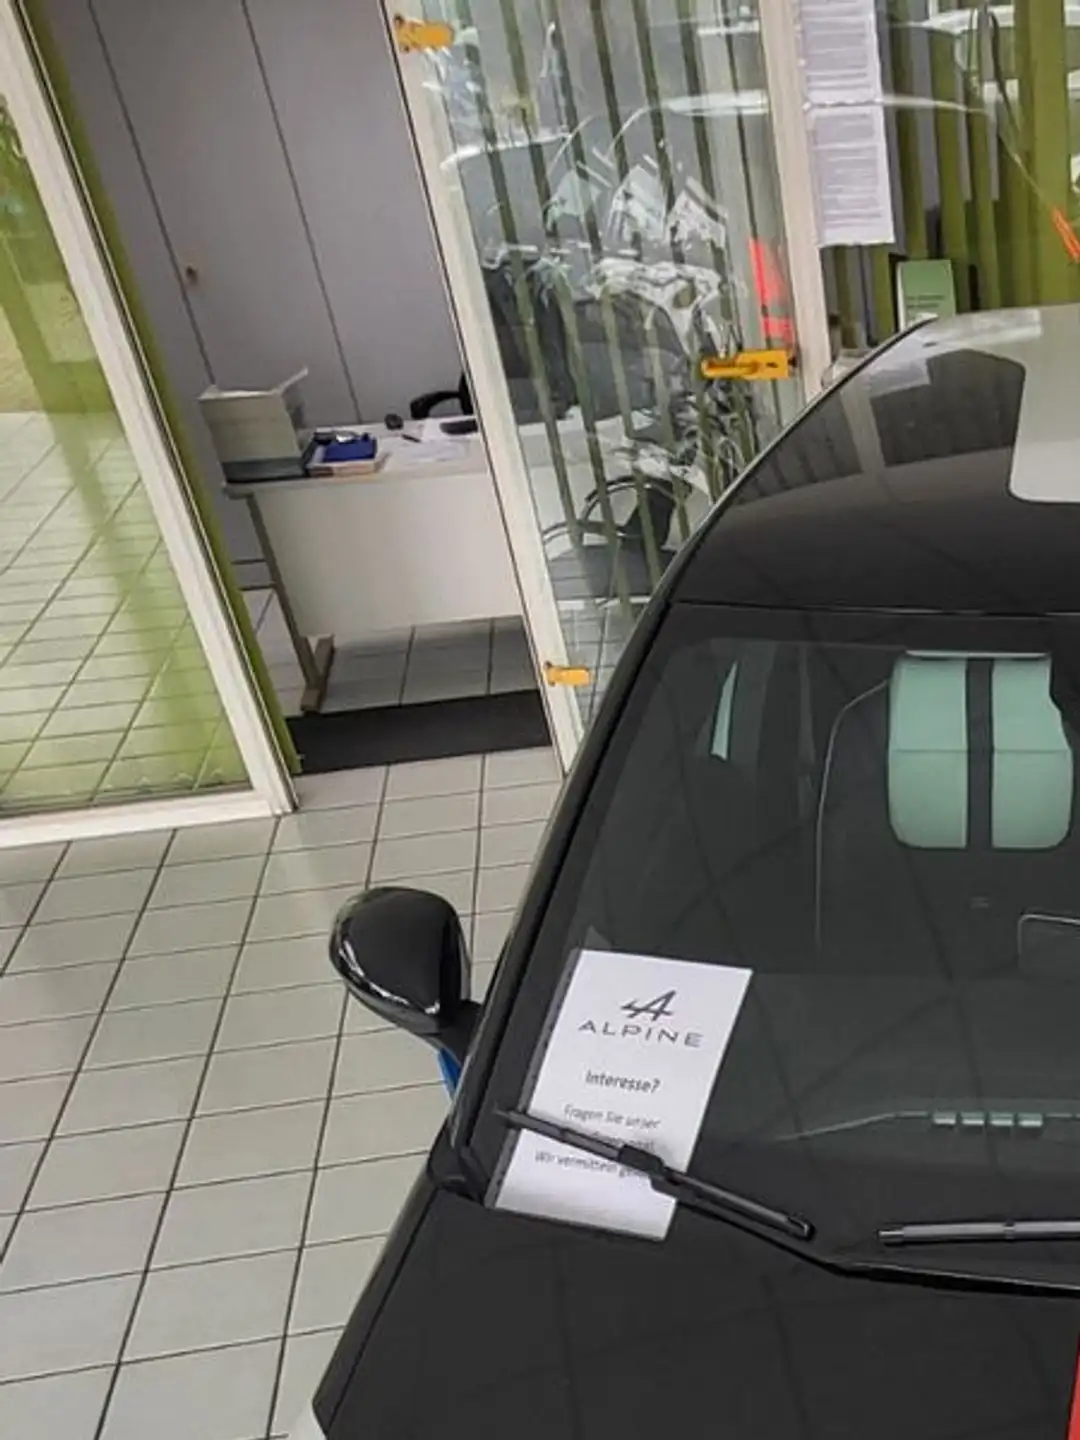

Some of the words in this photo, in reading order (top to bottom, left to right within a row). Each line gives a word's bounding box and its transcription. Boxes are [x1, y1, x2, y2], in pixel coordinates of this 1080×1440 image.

[578, 1020, 703, 1048] ALPINE
[585, 1070, 661, 1094] Interesse?
[564, 1104, 604, 1123] Fragen
[606, 1110, 624, 1125] Sie
[535, 1150, 555, 1163] Wir
